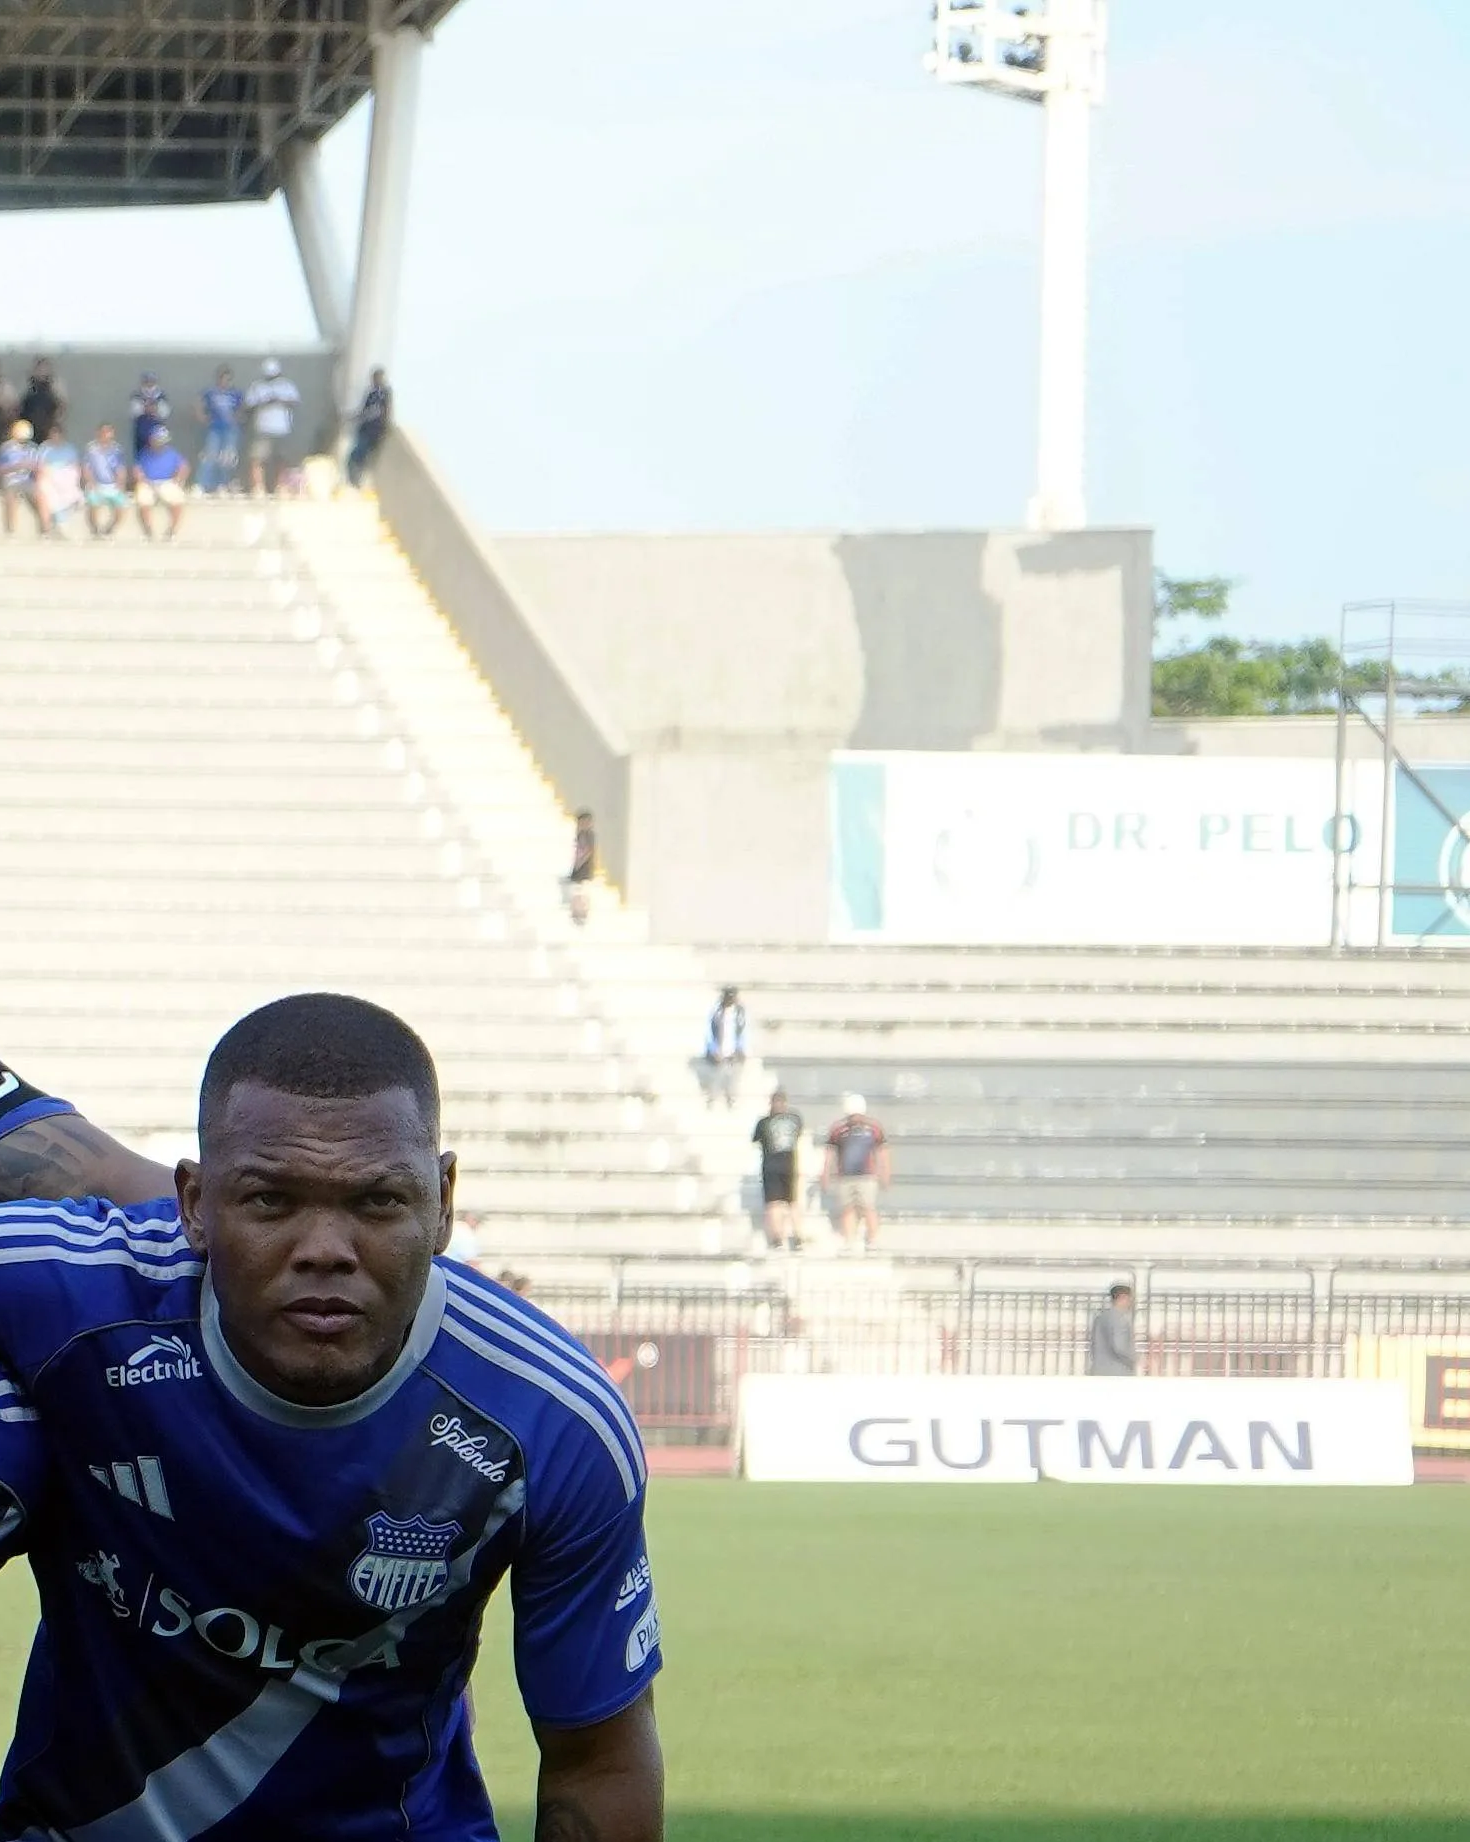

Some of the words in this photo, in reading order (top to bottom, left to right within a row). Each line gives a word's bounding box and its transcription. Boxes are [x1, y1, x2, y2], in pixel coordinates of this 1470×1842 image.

[1067, 810, 1168, 852] DR.
[1197, 812, 1363, 856] PELO
[430, 1413, 508, 1484] Splendo
[849, 1418, 1315, 1473] GUTMAN
[352, 1554, 449, 1608] EMELEC
[151, 1587, 401, 1675] SOLCA
